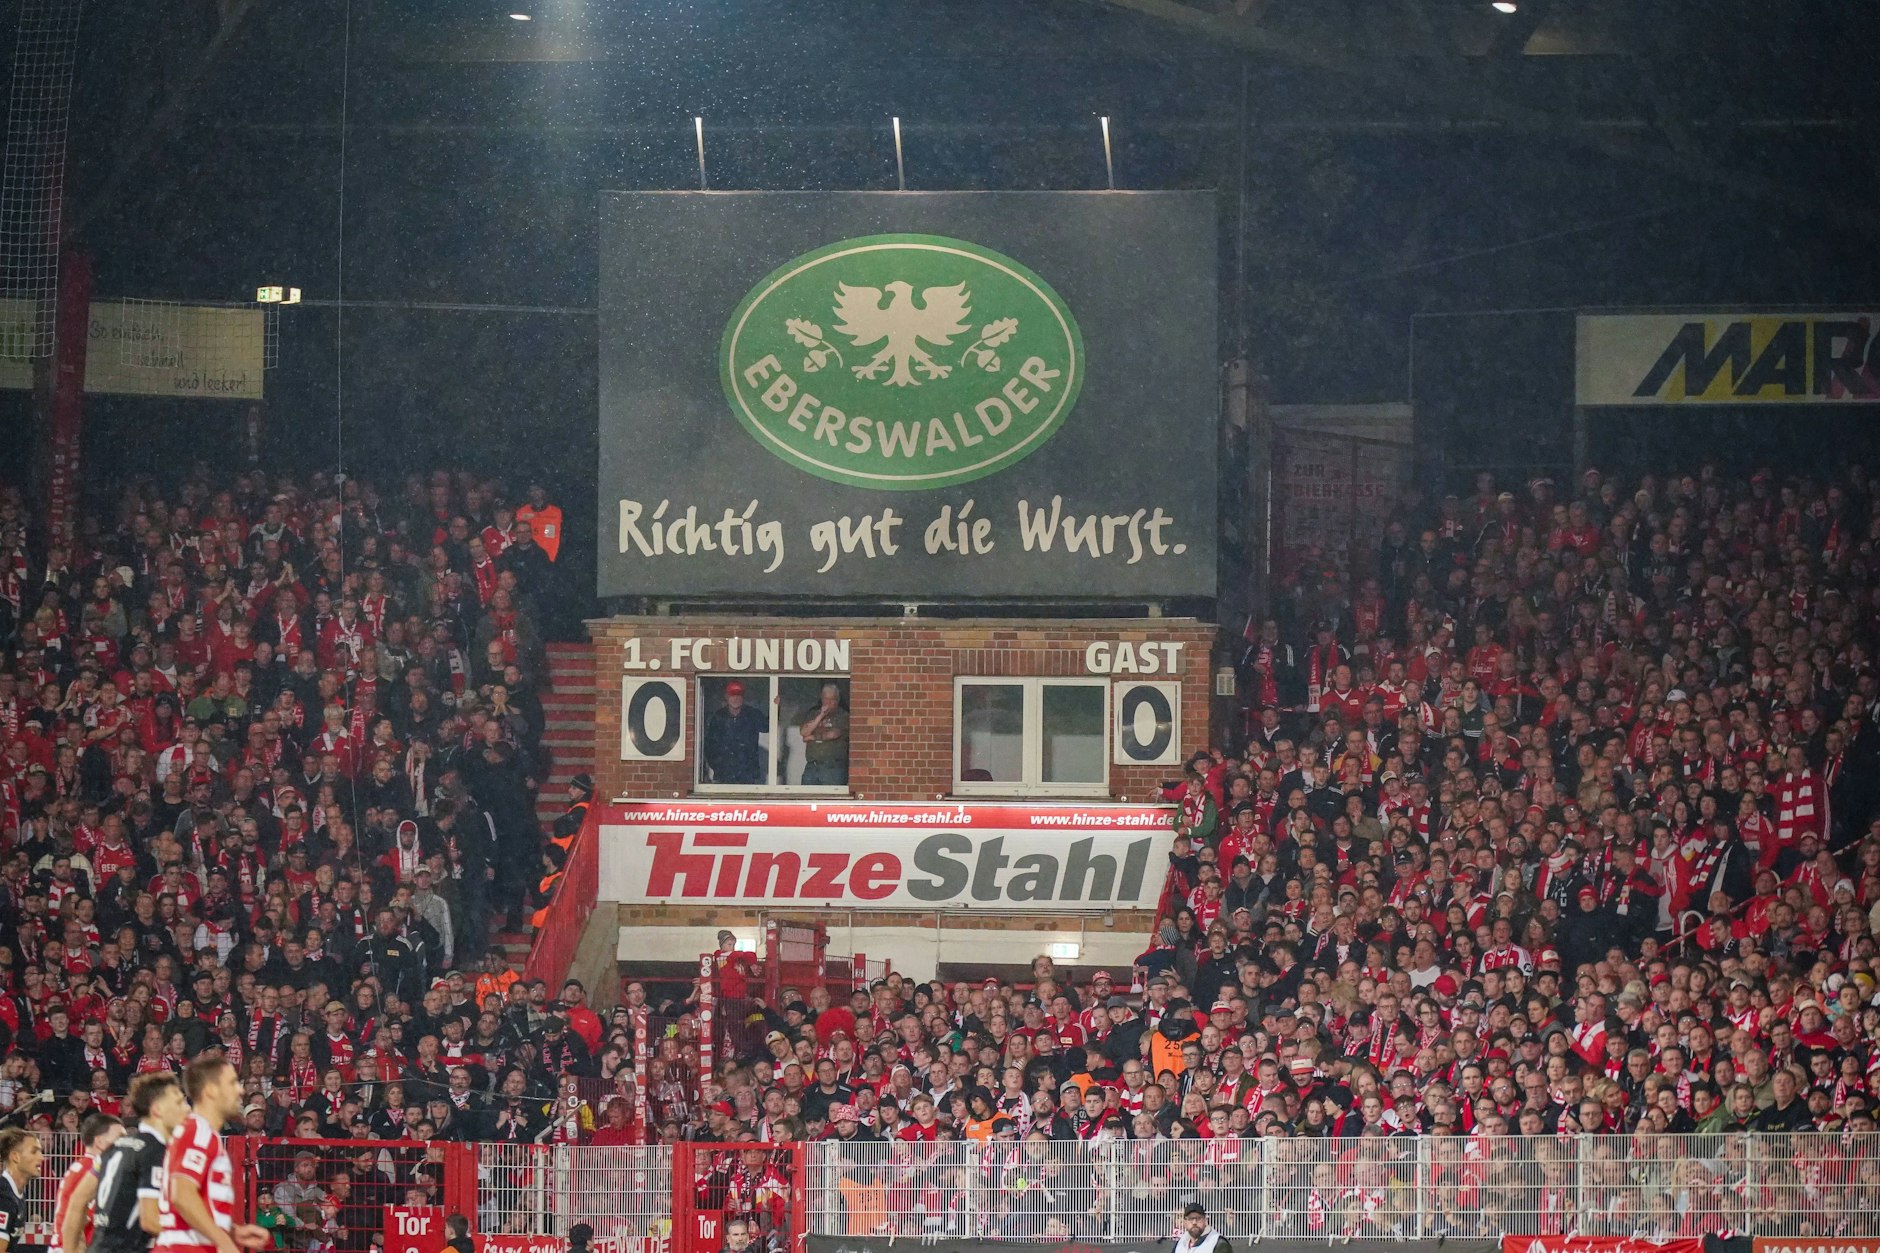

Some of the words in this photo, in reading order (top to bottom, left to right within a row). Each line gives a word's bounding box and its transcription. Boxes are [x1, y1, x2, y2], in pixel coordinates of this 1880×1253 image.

[1632, 321, 1880, 397] MAR
[743, 353, 1060, 459] EBERSWALDER
[618, 498, 785, 574] Richtig
[809, 507, 903, 573] gut
[924, 498, 995, 555] die
[1017, 494, 1187, 565] Wurst.
[623, 637, 661, 671] 1.
[670, 637, 712, 670] FC
[727, 637, 850, 671] UNION
[1085, 641, 1184, 674] GAST
[627, 680, 681, 757] 0
[1121, 684, 1173, 761] 0
[624, 808, 769, 823] www.hinze-stahl.de
[826, 810, 973, 825] www.hinze-stahl.de
[1030, 812, 1175, 827] www.hinze-stahl.de
[394, 1211, 431, 1236] Tor
[697, 1214, 717, 1239] Tor
